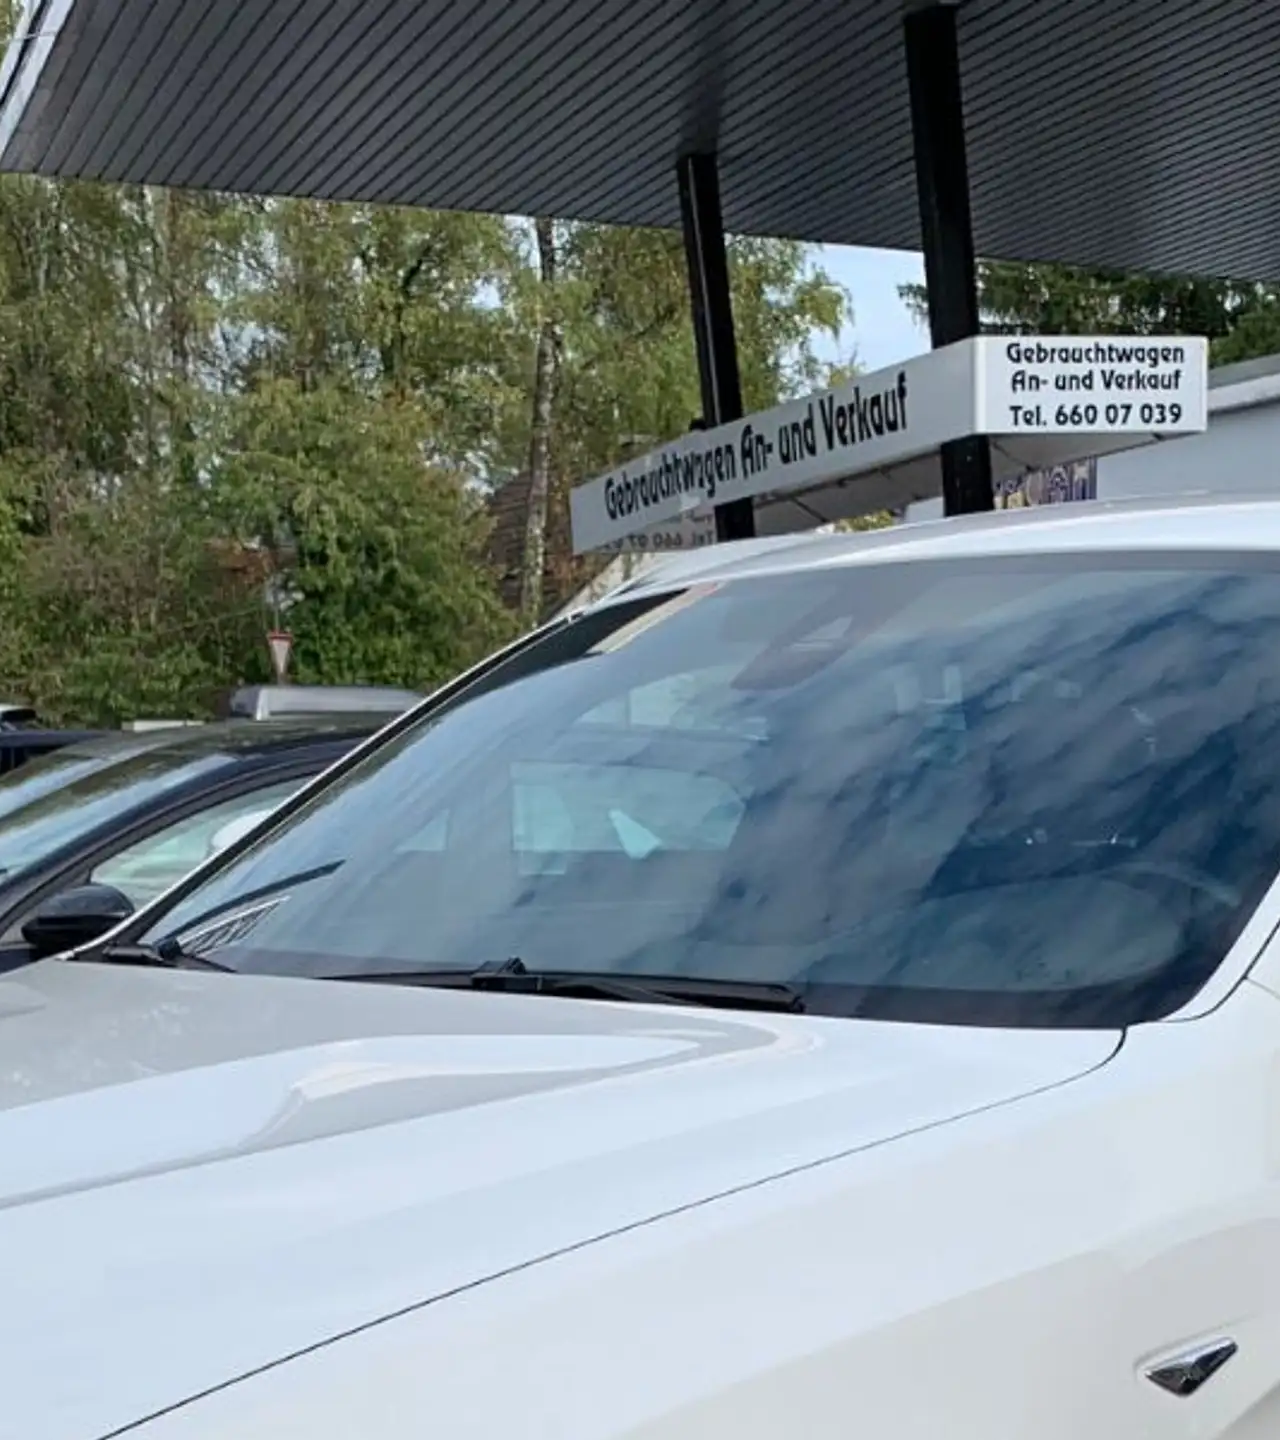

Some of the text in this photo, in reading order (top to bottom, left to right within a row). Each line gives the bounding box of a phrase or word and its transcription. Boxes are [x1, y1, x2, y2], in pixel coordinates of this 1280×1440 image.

[1006, 342, 1185, 368] Gebrauchtwagen
[1011, 369, 1182, 393] An- und Verkauf
[1009, 403, 1182, 426] Tel. 660 07 039
[604, 371, 907, 520] Gebrauchtwagen An- und Verkauf
